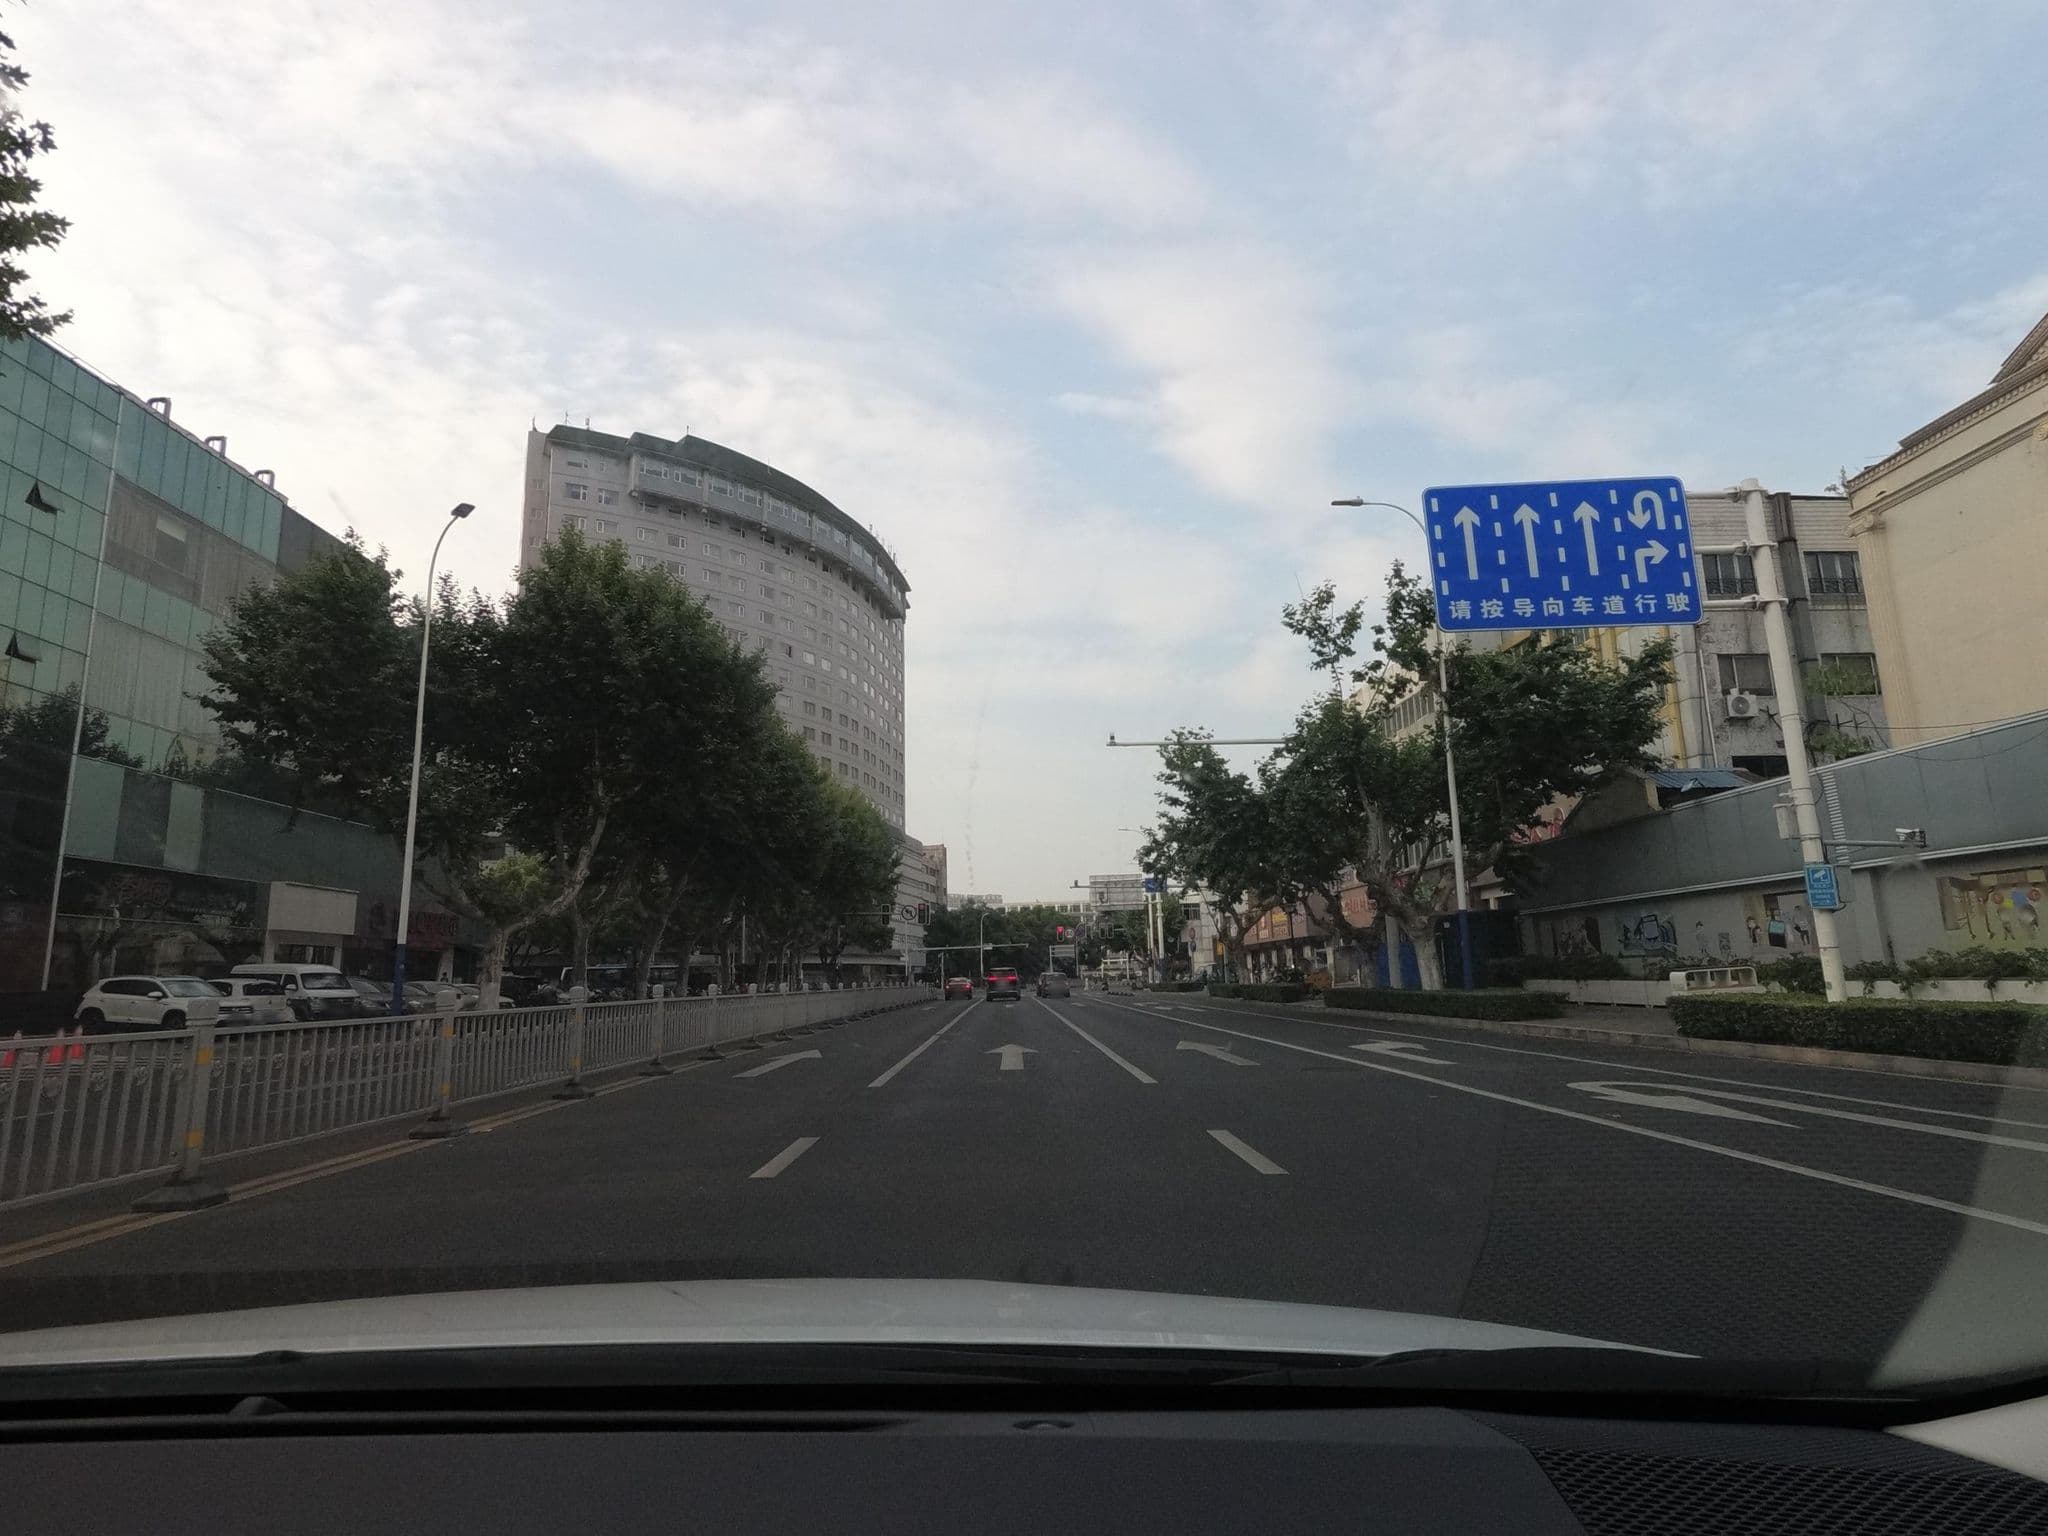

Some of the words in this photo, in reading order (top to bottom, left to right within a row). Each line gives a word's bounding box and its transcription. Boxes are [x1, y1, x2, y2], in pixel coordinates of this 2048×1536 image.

[1449, 593, 1690, 619] 请按导向车道行驶
